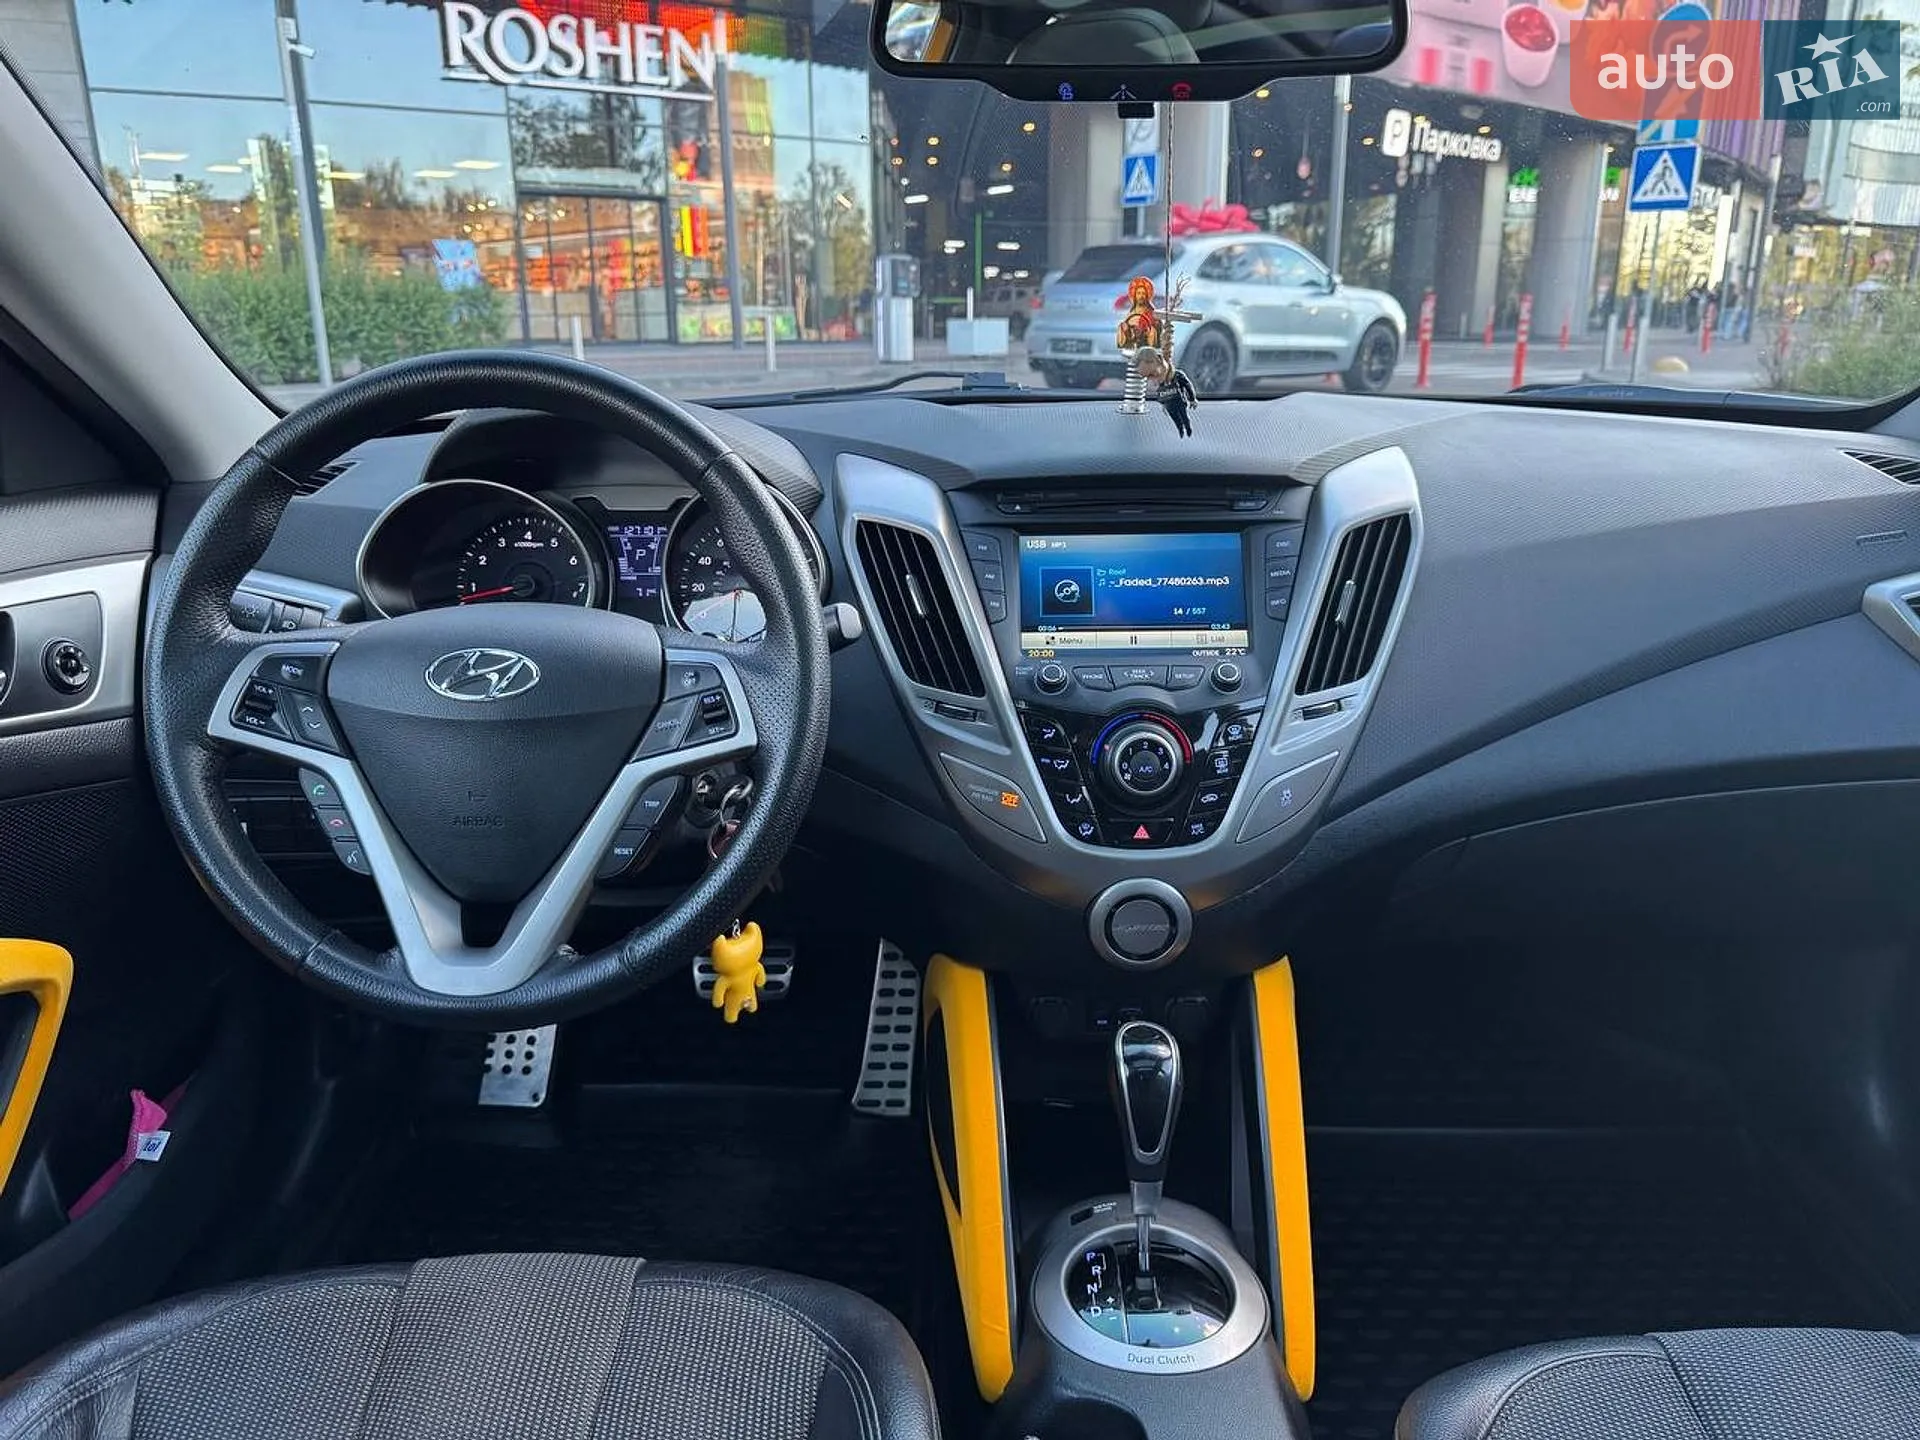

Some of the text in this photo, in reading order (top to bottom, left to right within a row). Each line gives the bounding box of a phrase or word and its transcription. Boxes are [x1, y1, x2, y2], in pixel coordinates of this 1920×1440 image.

[443, 1, 715, 90] ROSHEN
[1411, 120, 1502, 162] Парковка
[524, 531, 532, 540] 4
[498, 537, 506, 547] 3
[550, 537, 558, 547] 5
[1026, 540, 1047, 549] USB
[635, 548, 646, 561] P
[478, 555, 487, 565] 2
[569, 555, 578, 565] 6
[698, 556, 711, 566] 40
[471, 582, 477, 592] 1
[578, 583, 586, 592] 7
[692, 583, 705, 592] 20
[1173, 607, 1183, 615] 14
[1059, 637, 1083, 645] Menu
[1027, 649, 1055, 657] 20:00
[1142, 741, 1149, 749] 2
[1158, 747, 1164, 755] 3
[1121, 762, 1128, 770] 0
[1163, 761, 1170, 770] 4
[451, 815, 503, 827] AIRBAG
[1086, 1251, 1096, 1262] P
[1091, 1264, 1102, 1276] R
[1086, 1282, 1098, 1295] N
[1090, 1306, 1102, 1317] D
[1127, 1352, 1196, 1365] Dual Clutch
